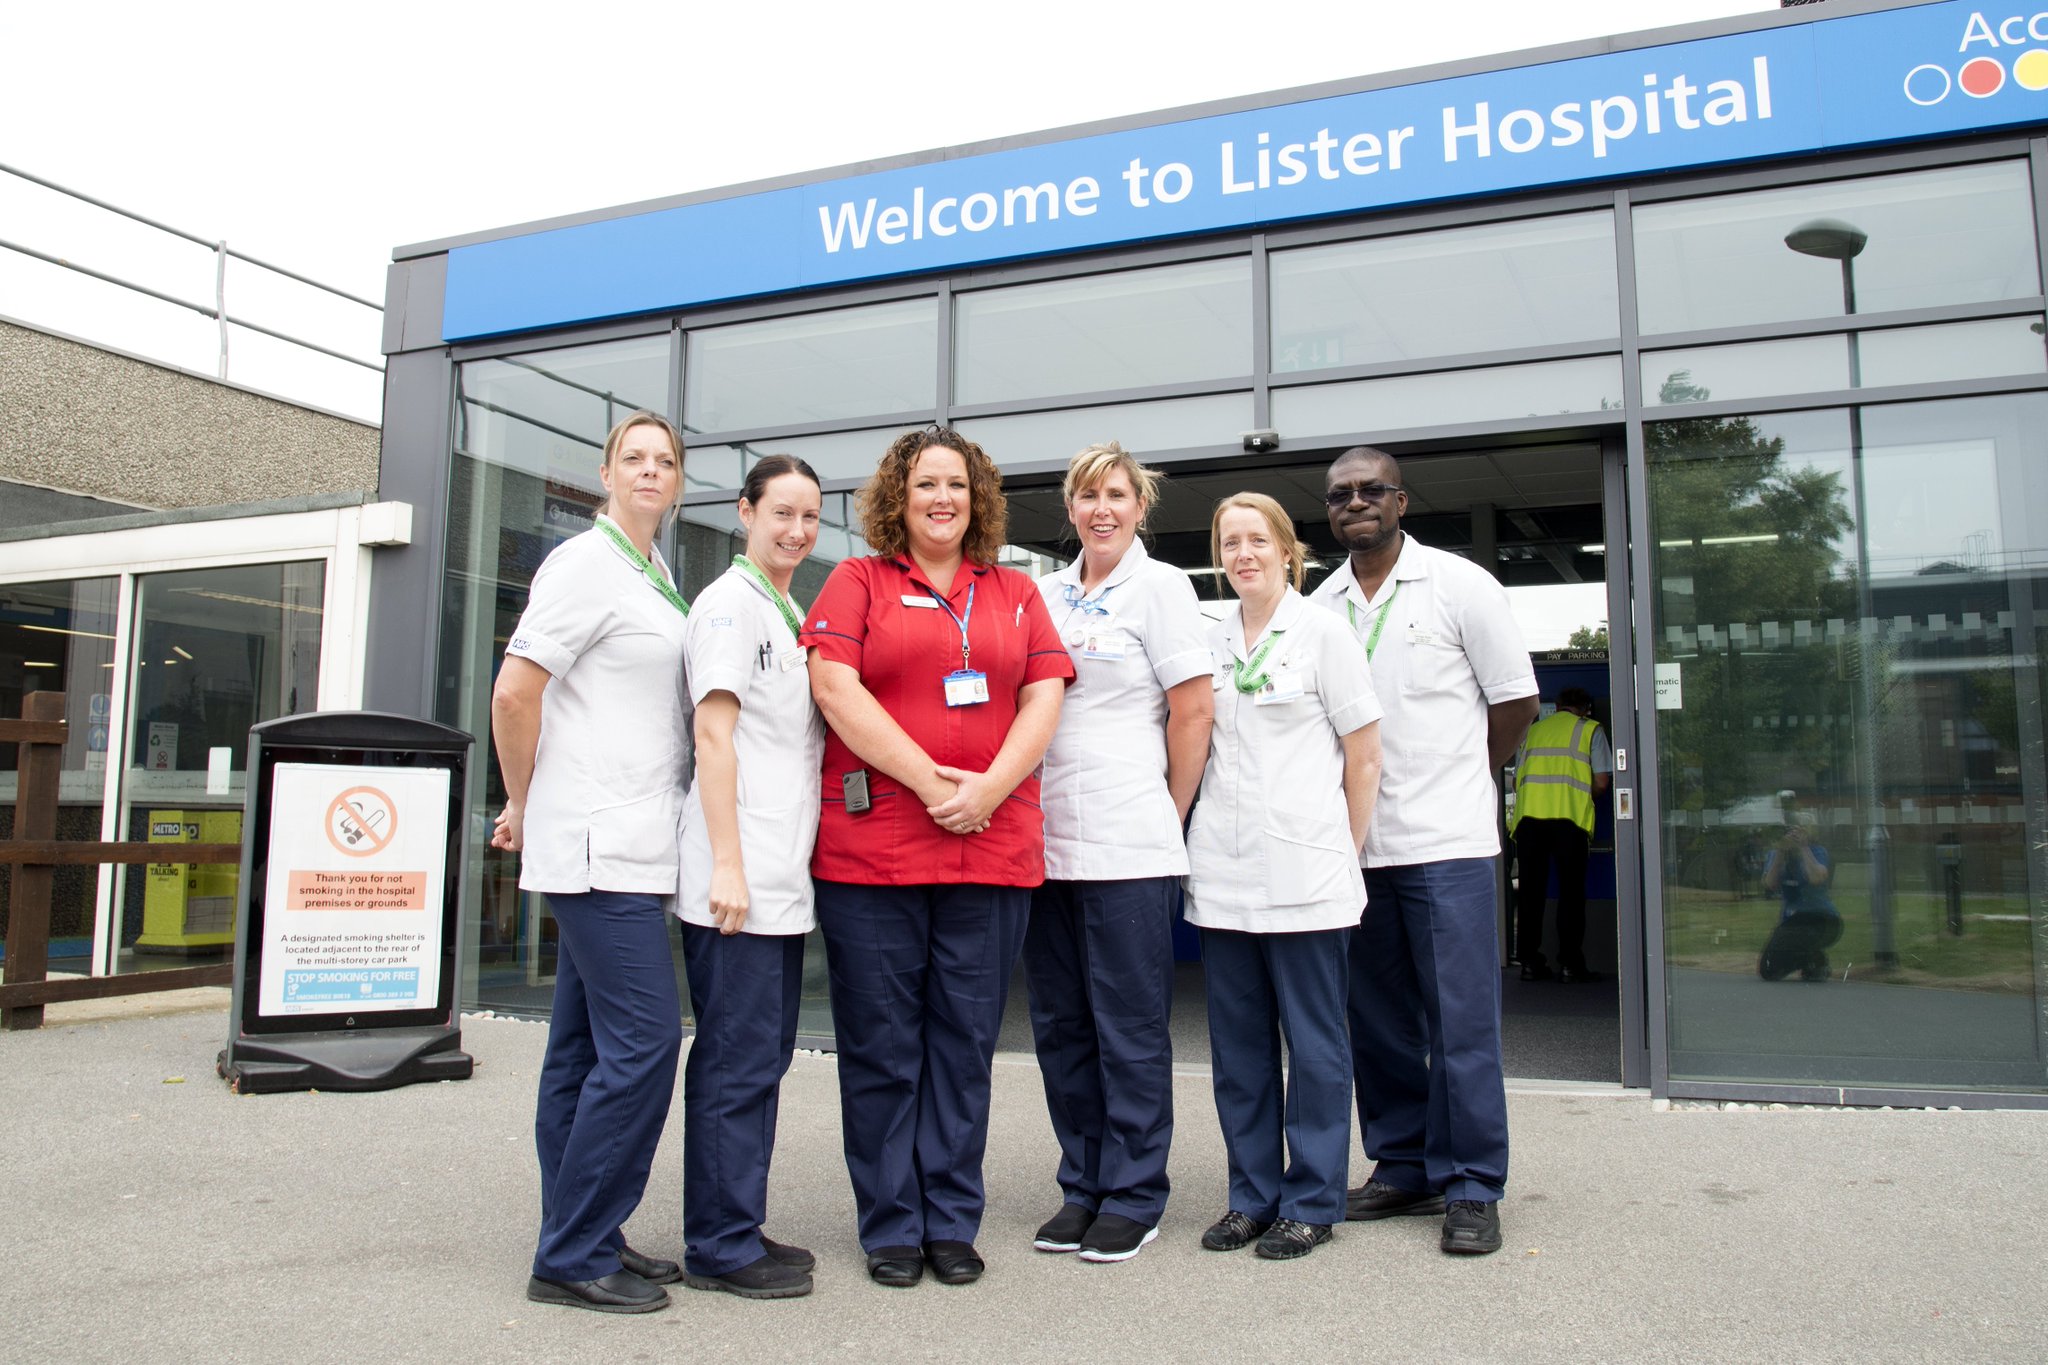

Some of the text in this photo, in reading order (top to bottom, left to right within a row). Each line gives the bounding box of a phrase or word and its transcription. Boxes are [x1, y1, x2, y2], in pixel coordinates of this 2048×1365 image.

[818, 56, 1772, 254] Welcome to Lister Hospital
[712, 617, 732, 628] NHS
[513, 639, 530, 650] NHS
[1568, 651, 1605, 659] PARKING
[153, 823, 180, 834] METRO
[150, 868, 179, 876] TALKING
[315, 873, 402, 885] Thank you for not
[299, 886, 415, 897] smoking in the hospital
[305, 899, 351, 909] premises
[367, 899, 408, 909] grounds
[281, 933, 425, 944] A designated smoking shelter is
[285, 946, 320, 954] located
[322, 945, 361, 955] adjacent
[363, 945, 373, 953] to
[375, 945, 389, 953] the
[411, 944, 421, 952] of
[297, 957, 312, 965] the
[314, 956, 369, 966] multi-storey
[388, 956, 408, 965] park
[287, 970, 416, 983] STOP SMOKING FOR FREE
